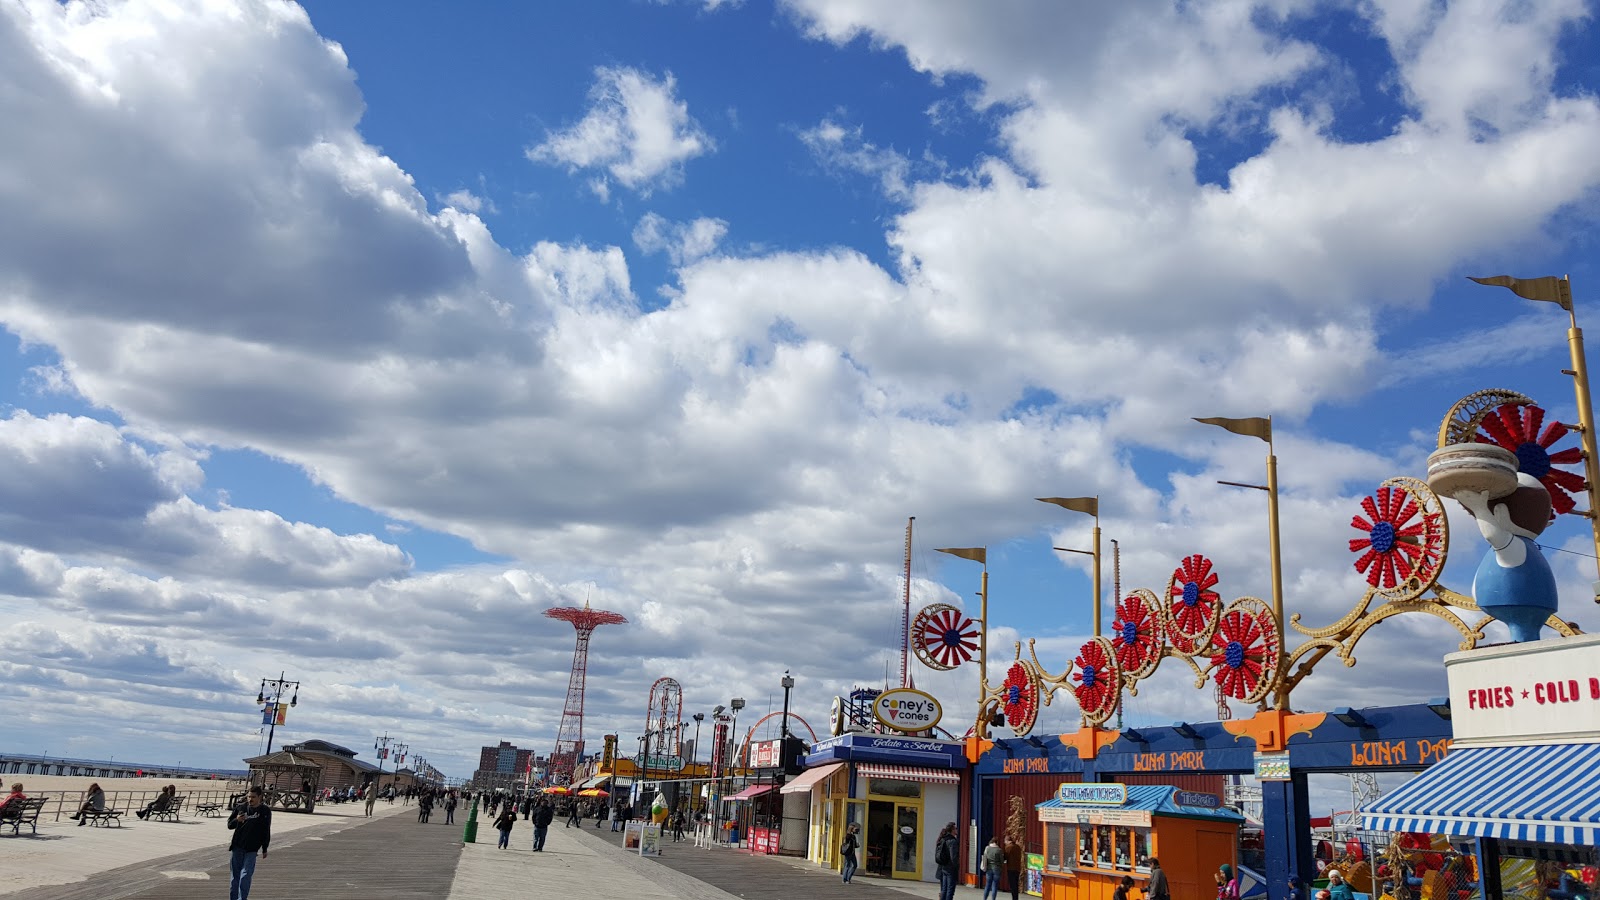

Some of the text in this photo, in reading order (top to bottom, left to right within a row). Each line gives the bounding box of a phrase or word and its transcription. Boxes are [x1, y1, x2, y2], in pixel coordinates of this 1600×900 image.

[1468, 686, 1514, 710] FRIES
[1535, 680, 1580, 705] COLD
[882, 699, 934, 713] coney's
[898, 712, 929, 721] cones
[871, 739, 901, 747] Gelato
[910, 741, 943, 751] Sorbet
[1351, 741, 1407, 765] LUNA
[1003, 758, 1049, 773] LUNA PARK
[1133, 752, 1205, 771] LUNA PARK
[1181, 792, 1215, 806] Tickets
